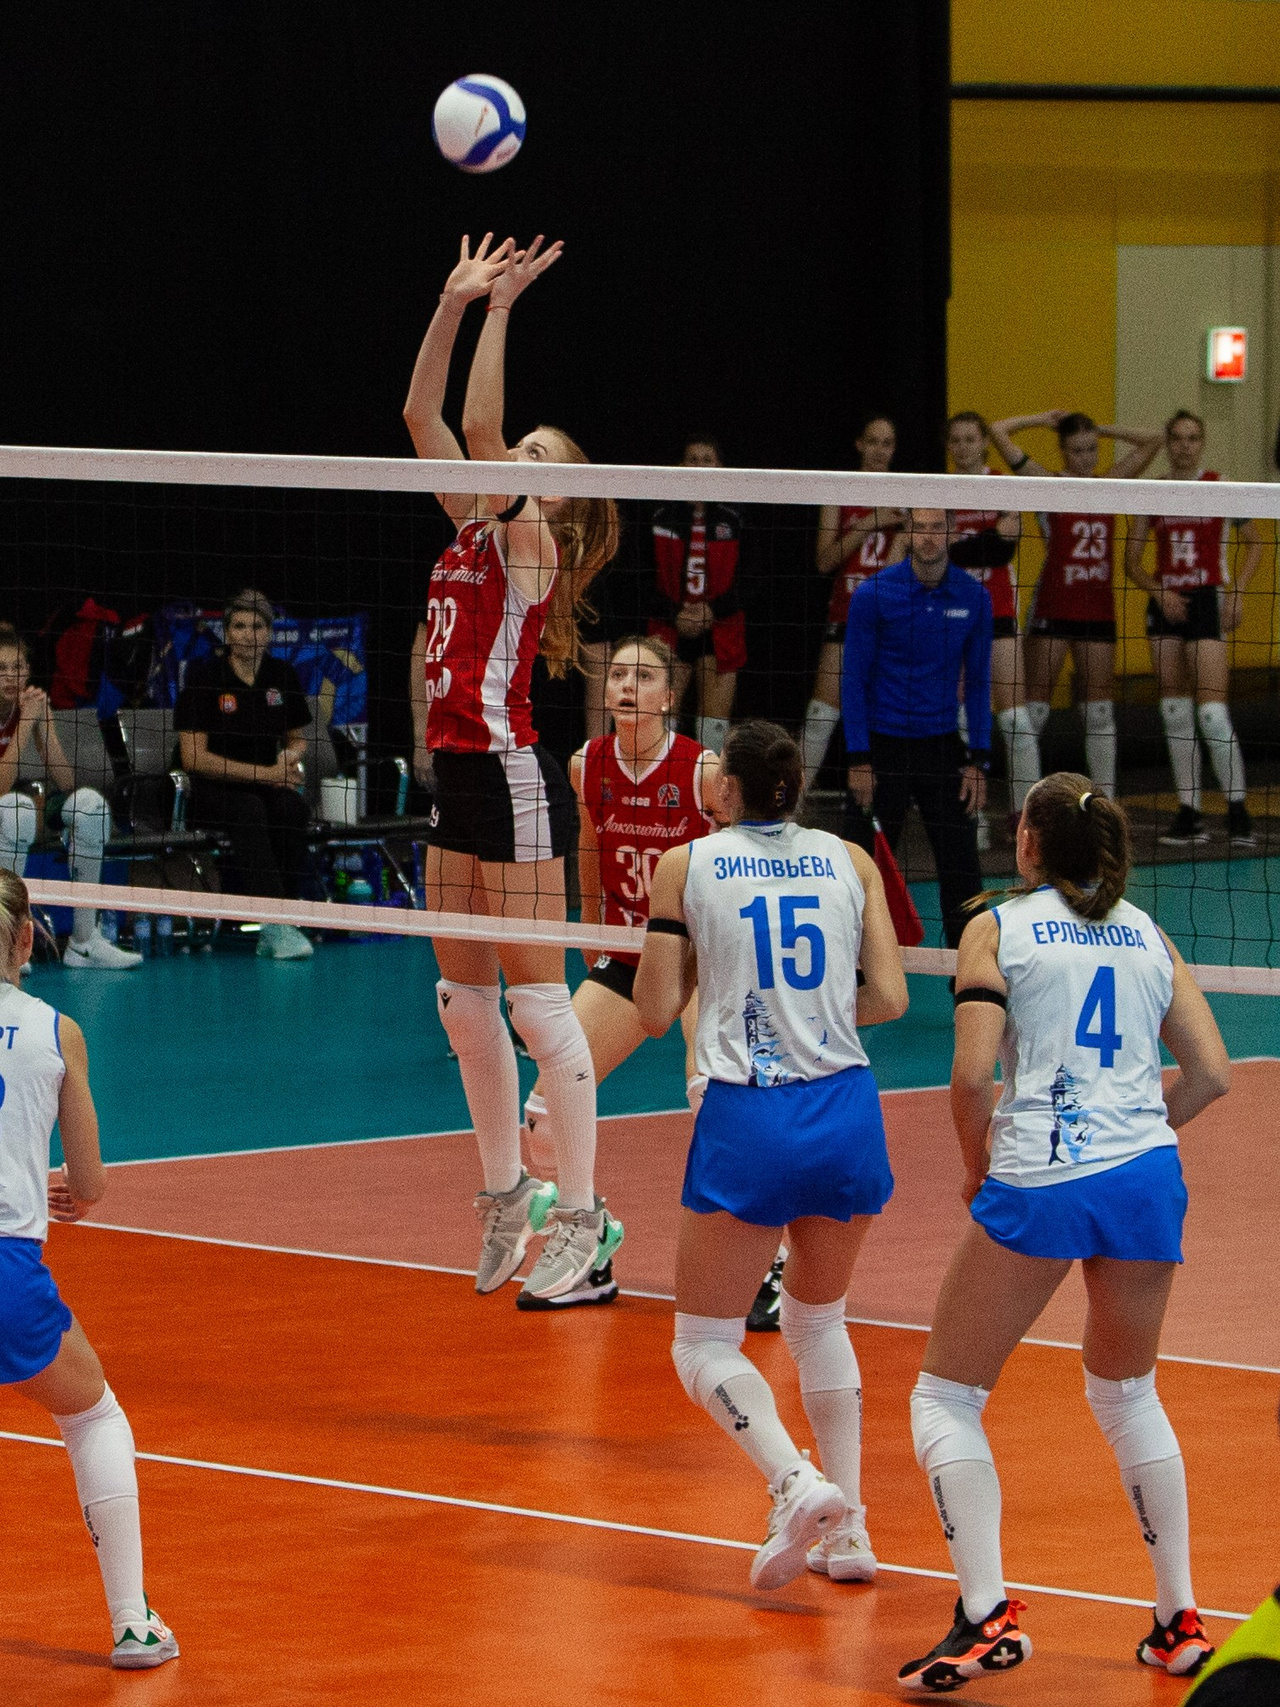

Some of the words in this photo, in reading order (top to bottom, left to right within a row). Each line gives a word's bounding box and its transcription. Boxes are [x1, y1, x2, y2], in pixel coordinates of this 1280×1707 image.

[1072, 521, 1107, 559] 23
[686, 557, 706, 595] 5
[425, 597, 457, 663] 29
[596, 814, 689, 838] Локомотив
[714, 856, 837, 880] ЗИНОВЬЕВА
[739, 895, 826, 990] 15
[1032, 920, 1148, 951] ЕРЛЫКОВА
[1075, 965, 1122, 1068] 4
